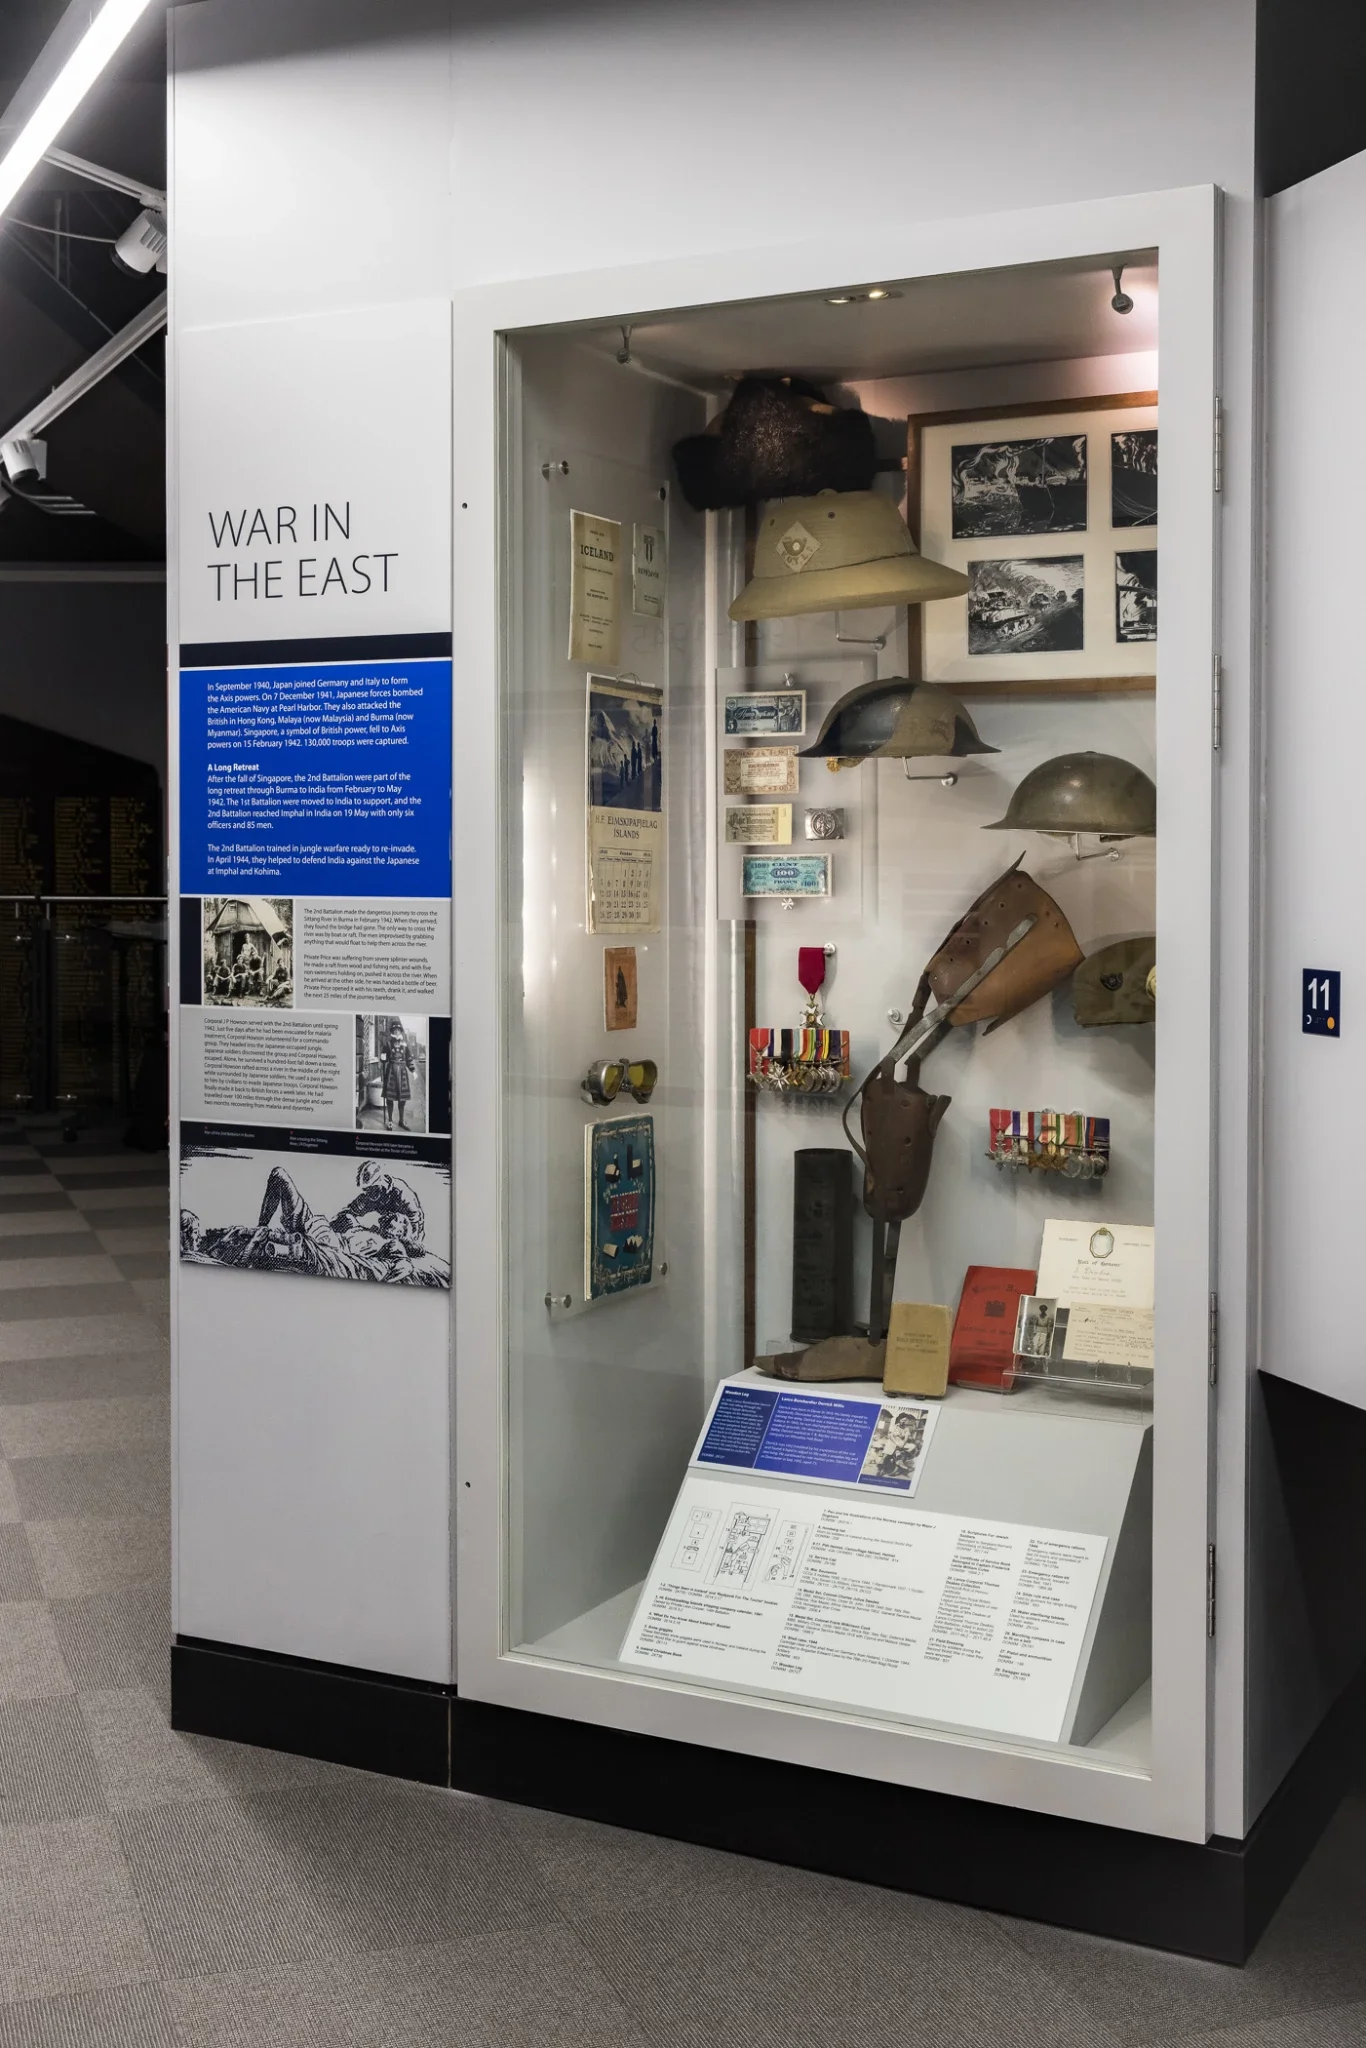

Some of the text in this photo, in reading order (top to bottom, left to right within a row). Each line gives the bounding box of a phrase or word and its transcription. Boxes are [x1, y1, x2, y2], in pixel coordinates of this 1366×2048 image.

[208, 501, 350, 548] WAR IN
[580, 544, 614, 562] ICELAND
[207, 553, 399, 601] THE EAST
[215, 681, 252, 692] September
[253, 681, 272, 691] 1940,
[272, 680, 293, 690] Japan
[293, 679, 316, 690] joined
[316, 678, 349, 689] Germany
[349, 677, 364, 685] and
[365, 677, 380, 687] Italy
[381, 676, 389, 684] to
[390, 676, 408, 684] form
[207, 694, 218, 702] the
[219, 694, 233, 702] Axis
[234, 694, 261, 703] powers.
[261, 692, 272, 700] On
[279, 691, 314, 700] December
[317, 690, 336, 701] 1941,
[336, 689, 368, 700] Japanese
[369, 688, 391, 697] forces
[392, 687, 423, 696] bombed
[207, 705, 219, 713] the
[219, 704, 251, 713] American
[252, 704, 269, 714] Navy
[279, 703, 296, 711] Pearl
[297, 702, 323, 711] Harbor.
[323, 702, 340, 712] They
[341, 701, 356, 709] also
[357, 701, 387, 709] attacked
[389, 700, 401, 708] the
[207, 711, 414, 726] British in Hong Kong, Malaya (now Malaysia) and Burma (now
[727, 720, 734, 730] 5
[207, 728, 243, 739] Myanmar).
[243, 727, 280, 738] Singapore,
[286, 726, 311, 737] symbol
[312, 726, 320, 734] of
[320, 726, 343, 734] British
[344, 726, 369, 735] power,
[381, 724, 389, 732] to
[390, 724, 405, 732] Axis
[207, 741, 231, 750] powers
[243, 739, 251, 747] 15
[252, 739, 282, 749] February
[284, 738, 303, 746] 1942.
[304, 738, 331, 748] 130,000
[332, 737, 355, 748] troops
[374, 736, 409, 747] captured.
[207, 763, 213, 771] A
[213, 763, 232, 773] Long
[207, 774, 223, 782] After
[224, 774, 236, 782] the
[237, 774, 248, 782] fall
[248, 774, 256, 782] of
[257, 774, 294, 784] Singapore,
[294, 773, 306, 781] the
[307, 773, 321, 781] 2nd
[322, 773, 353, 781] Battalion
[373, 772, 388, 782] part
[389, 772, 397, 780] of
[398, 772, 411, 780] the
[207, 784, 402, 796] long retreat through Burma to India from February to May
[208, 797, 226, 805] 1942.
[226, 797, 239, 805] The
[240, 797, 250, 805] 1st
[251, 797, 281, 805] Battalion
[300, 797, 325, 805] moved
[326, 797, 334, 805] to
[362, 796, 393, 807] support,
[393, 796, 408, 804] and
[409, 796, 421, 804] the
[207, 809, 220, 817] 2nd
[221, 809, 251, 817] Battalion
[280, 809, 304, 819] Imphal
[305, 808, 313, 816] in
[314, 808, 331, 816] India
[344, 808, 353, 816] 19
[353, 808, 369, 818] May
[370, 808, 386, 816] with
[387, 808, 403, 818] only
[404, 808, 414, 816] six
[207, 820, 231, 828] officers
[232, 820, 245, 828] and
[207, 843, 220, 851] The
[221, 843, 234, 851] 2nd
[235, 843, 265, 851] Battalion
[299, 844, 322, 854] jungle
[323, 844, 349, 852] warfare
[350, 844, 371, 854] ready
[371, 844, 380, 852] to
[380, 844, 417, 852] re-invade.
[215, 855, 231, 865] April
[233, 855, 251, 865] 1944,
[251, 855, 267, 865] they
[268, 855, 292, 865] helped
[292, 855, 300, 863] to
[301, 855, 326, 863] defend
[346, 856, 372, 866] against
[373, 856, 385, 864] the
[386, 856, 419, 866] Japanese
[207, 866, 214, 874] at
[215, 866, 238, 877] Imphal
[1308, 977, 1330, 1011] 11
[724, 1389, 741, 1397] Wooden
